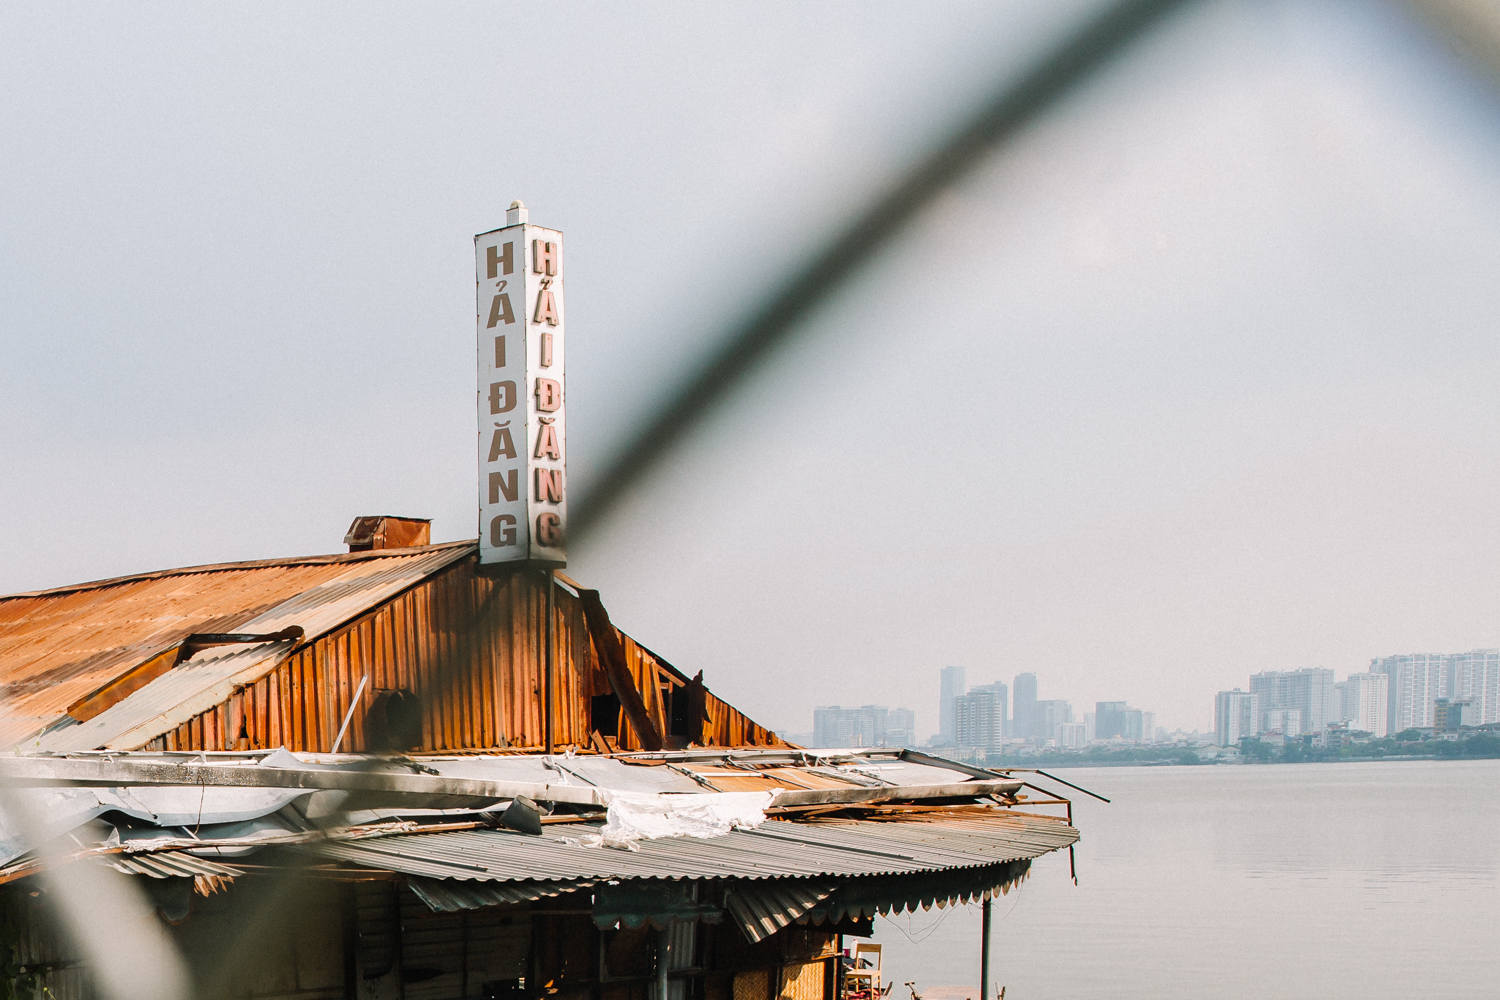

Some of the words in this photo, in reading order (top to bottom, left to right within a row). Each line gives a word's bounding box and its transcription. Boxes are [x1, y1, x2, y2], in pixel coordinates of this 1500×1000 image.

[486, 241, 516, 369] HẢI
[532, 238, 560, 368] HẢI
[487, 379, 519, 548] ĐĂNG
[534, 377, 563, 548] ĐĂNG
